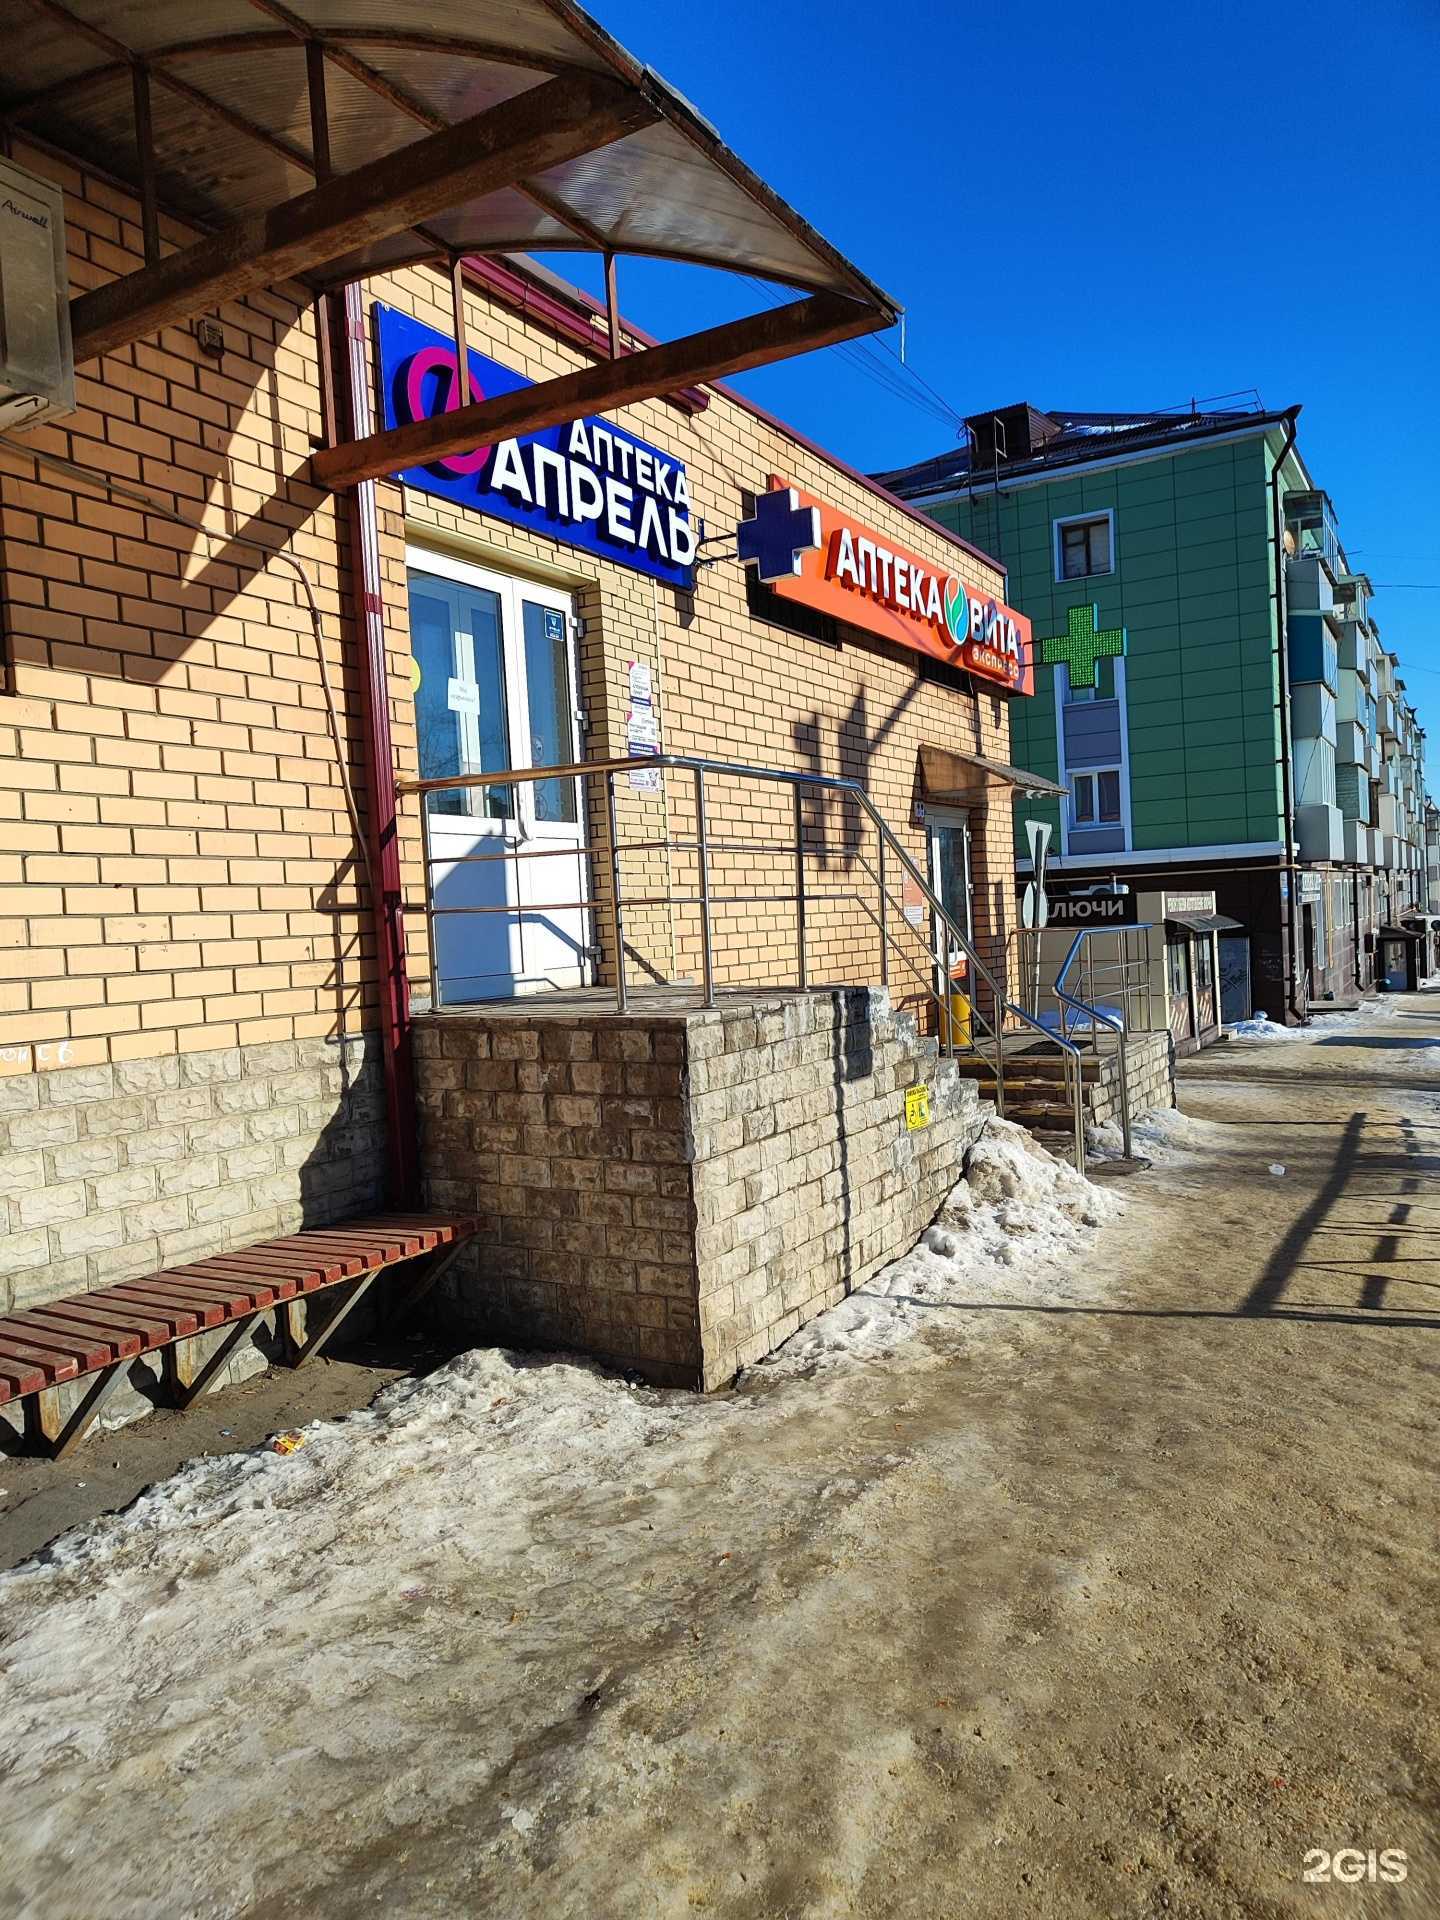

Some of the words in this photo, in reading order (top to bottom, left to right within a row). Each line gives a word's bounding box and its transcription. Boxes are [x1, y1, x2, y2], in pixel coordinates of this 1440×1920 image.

[490, 437, 697, 566] АПРЕЛЬ
[568, 418, 693, 511] АПТЕКА
[836, 527, 944, 625] АПТЕКА
[970, 598, 1019, 660] ВИТА
[1047, 900, 1124, 918] ЛЮЧИ
